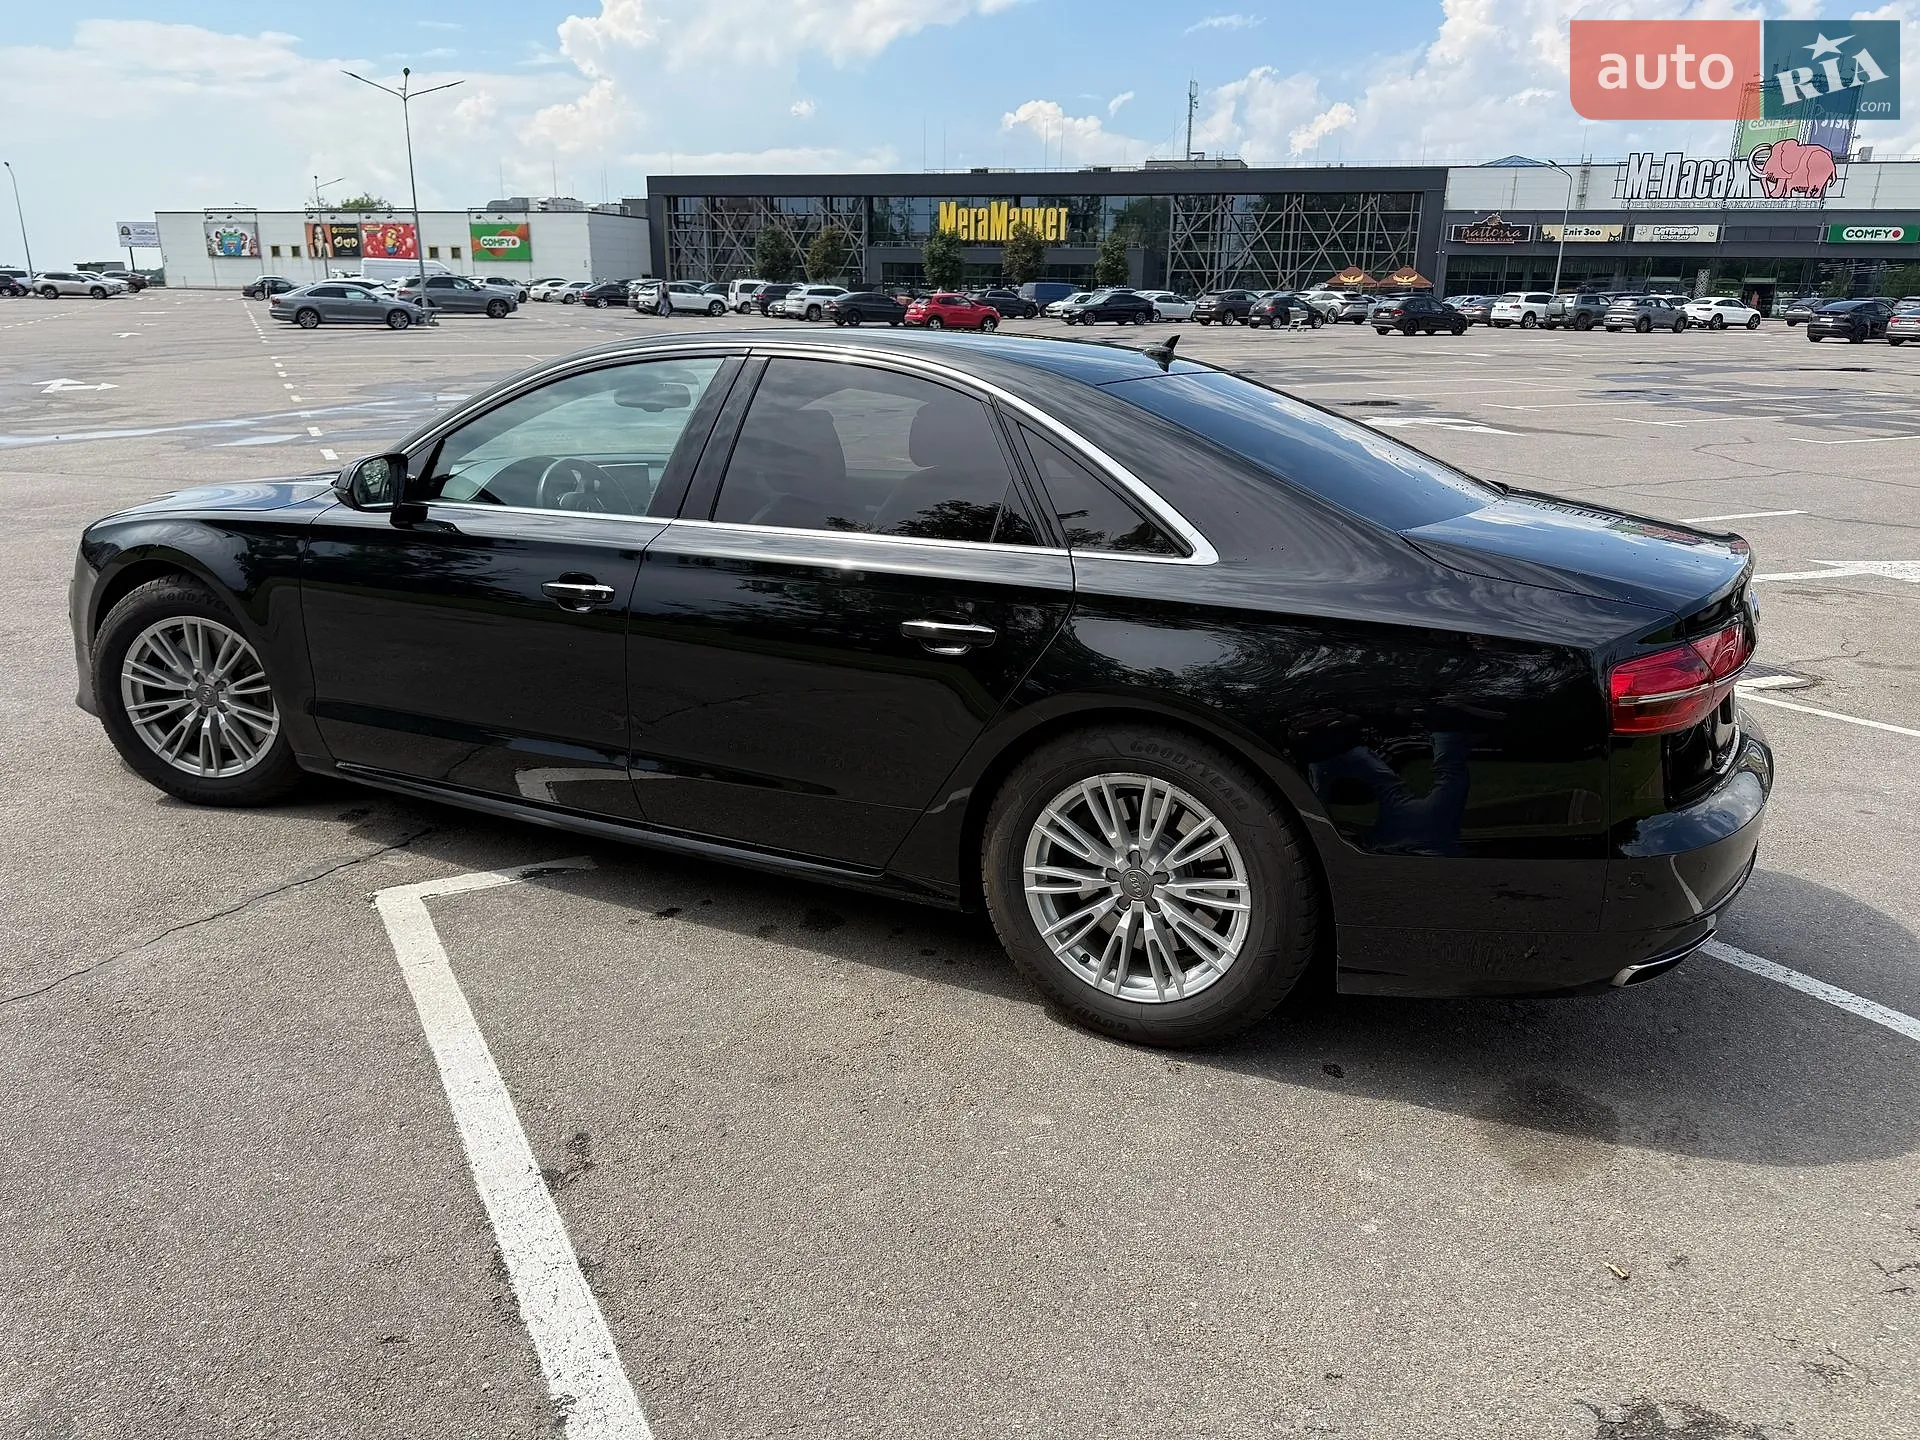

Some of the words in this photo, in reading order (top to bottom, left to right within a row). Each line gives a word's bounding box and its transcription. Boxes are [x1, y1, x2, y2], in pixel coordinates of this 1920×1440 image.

[1461, 226, 1522, 239] Trattoria
[1846, 229, 1892, 239] COMFY
[481, 238, 511, 247] COMFY
